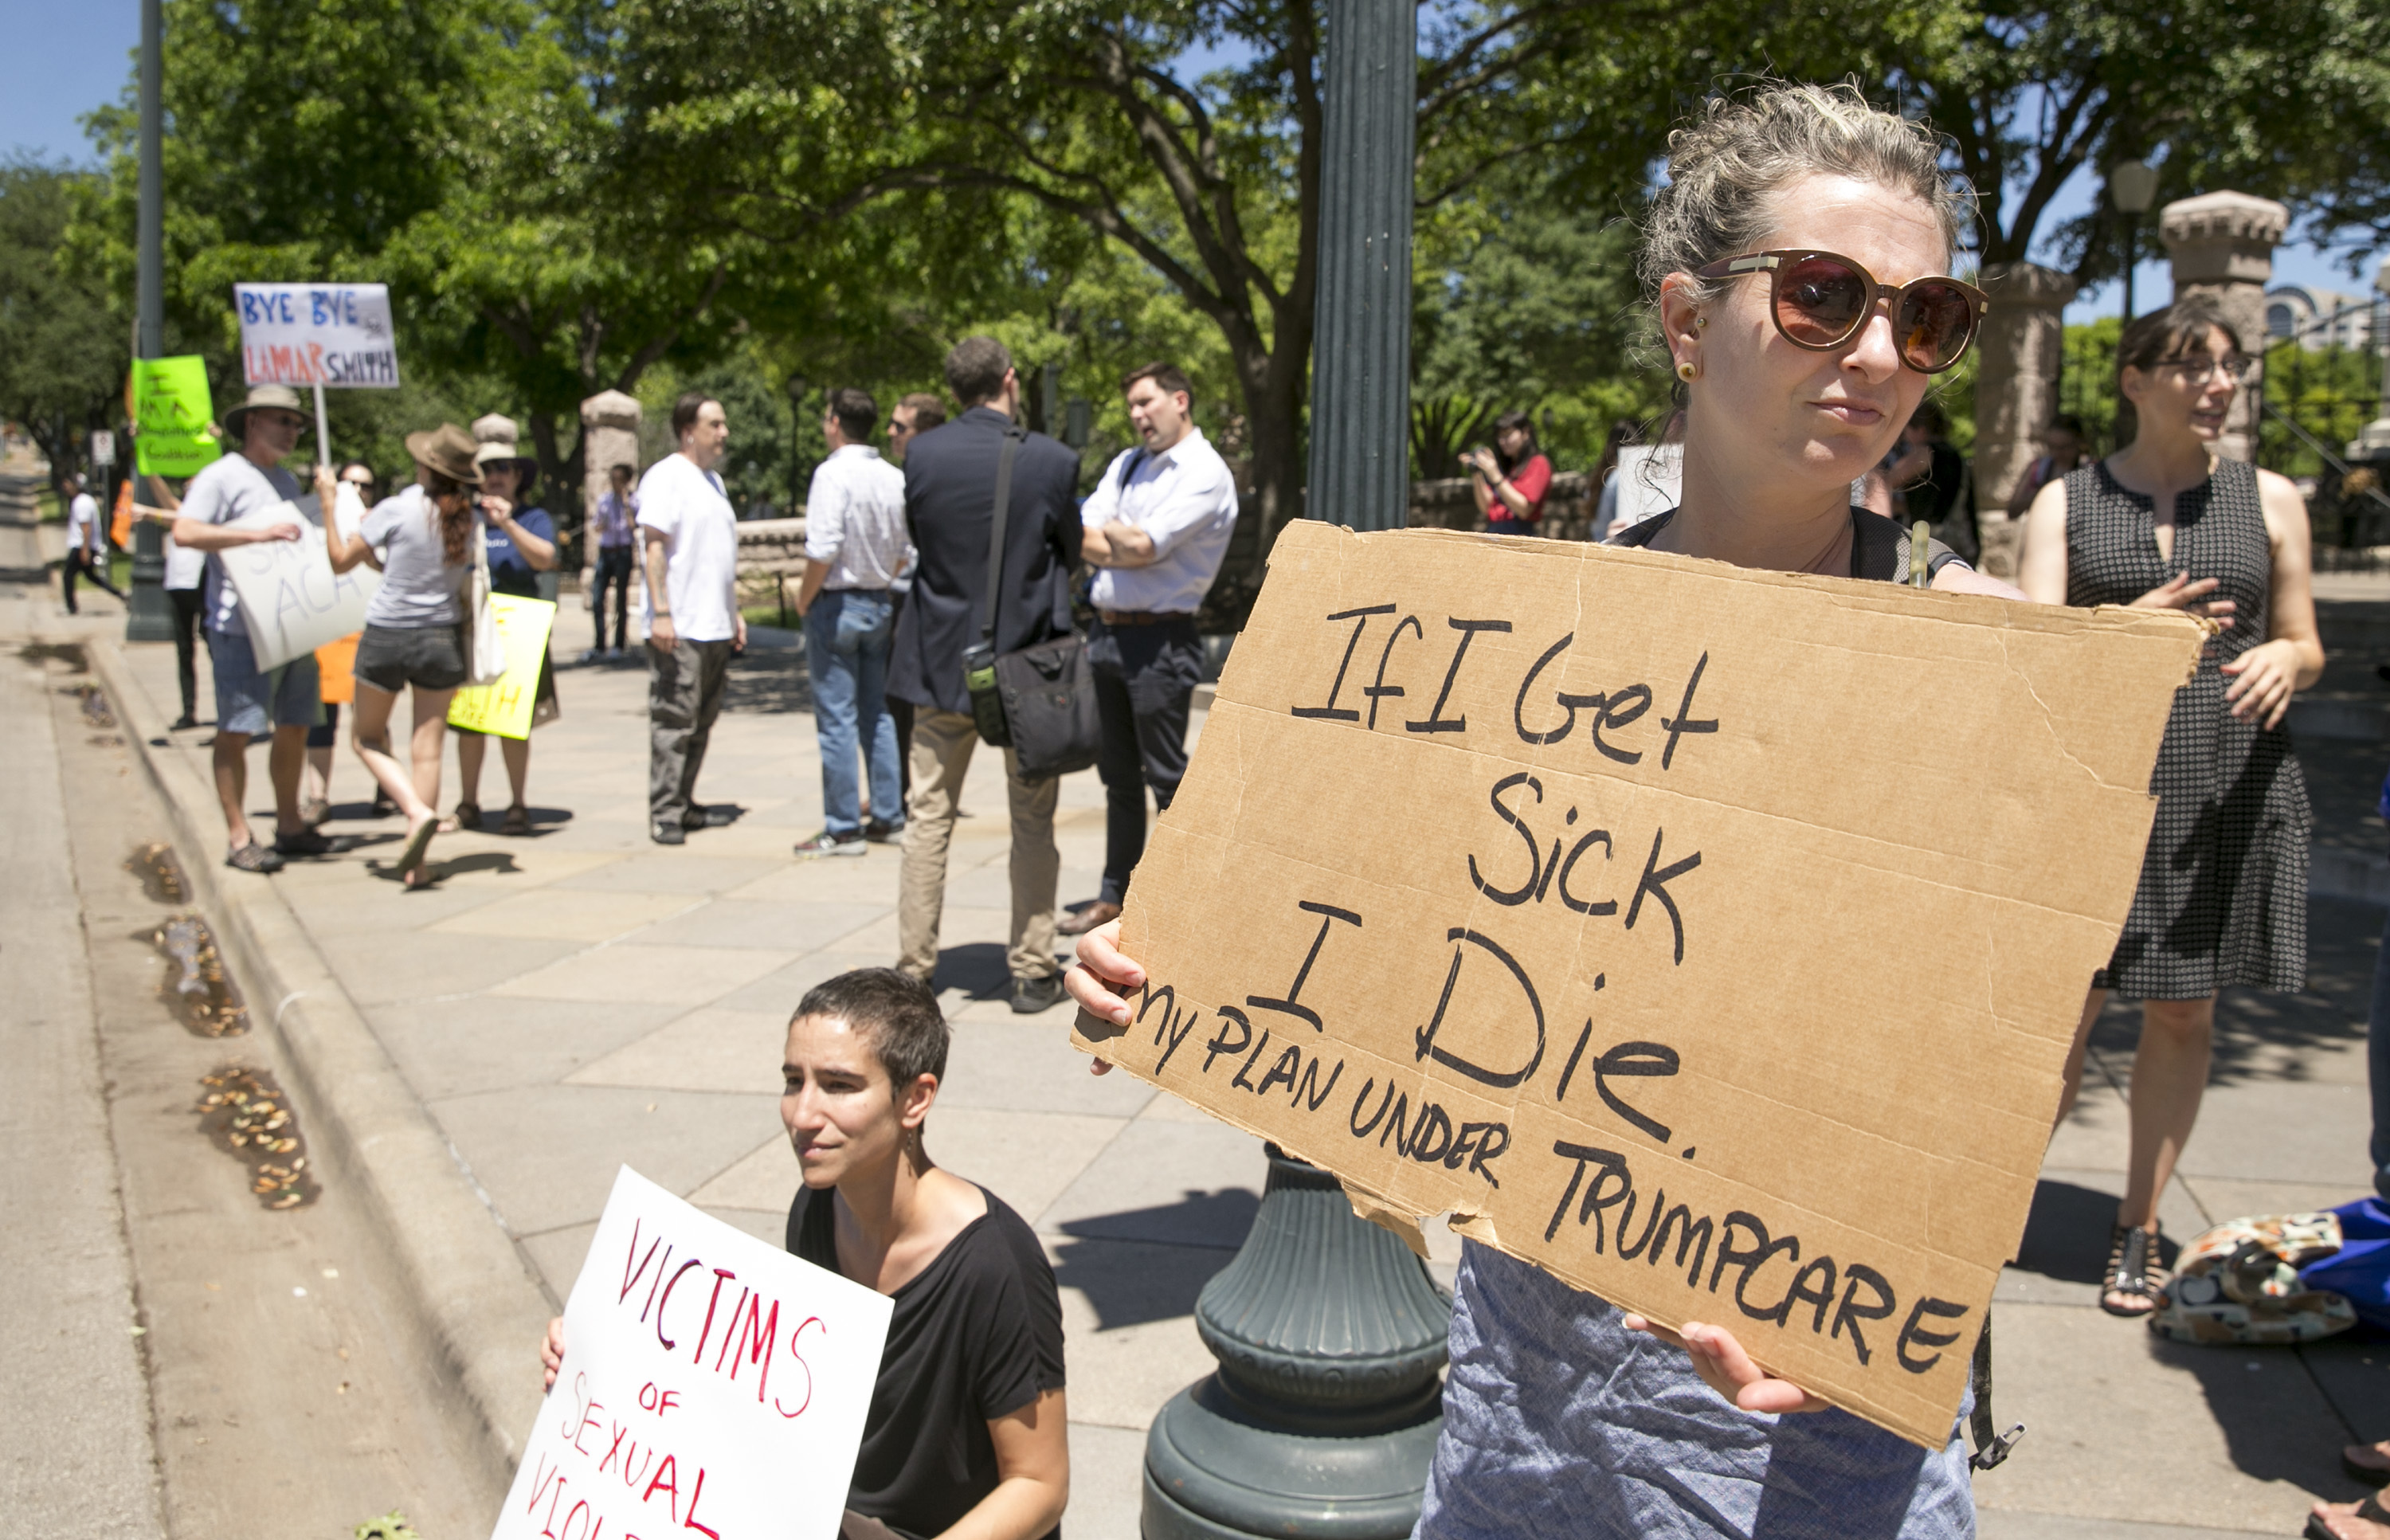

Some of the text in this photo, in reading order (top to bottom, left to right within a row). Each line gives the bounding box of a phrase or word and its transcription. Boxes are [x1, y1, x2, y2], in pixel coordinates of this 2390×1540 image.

[147, 373, 180, 395] I
[241, 291, 358, 326] BYE BYE
[246, 341, 394, 382] LAMAR SMITH
[1291, 603, 1719, 770] If I Get
[1468, 771, 1702, 966] Sick
[1246, 899, 1697, 1160] I Die.
[1202, 1005, 1344, 1112] PLAN
[1350, 1077, 1510, 1190] UNDER
[1543, 1139, 1969, 1375] TRUMPCARE
[619, 1217, 827, 1418] VICTIMS
[638, 1381, 680, 1417] OF
[562, 1371, 721, 1540] SEXUAL
